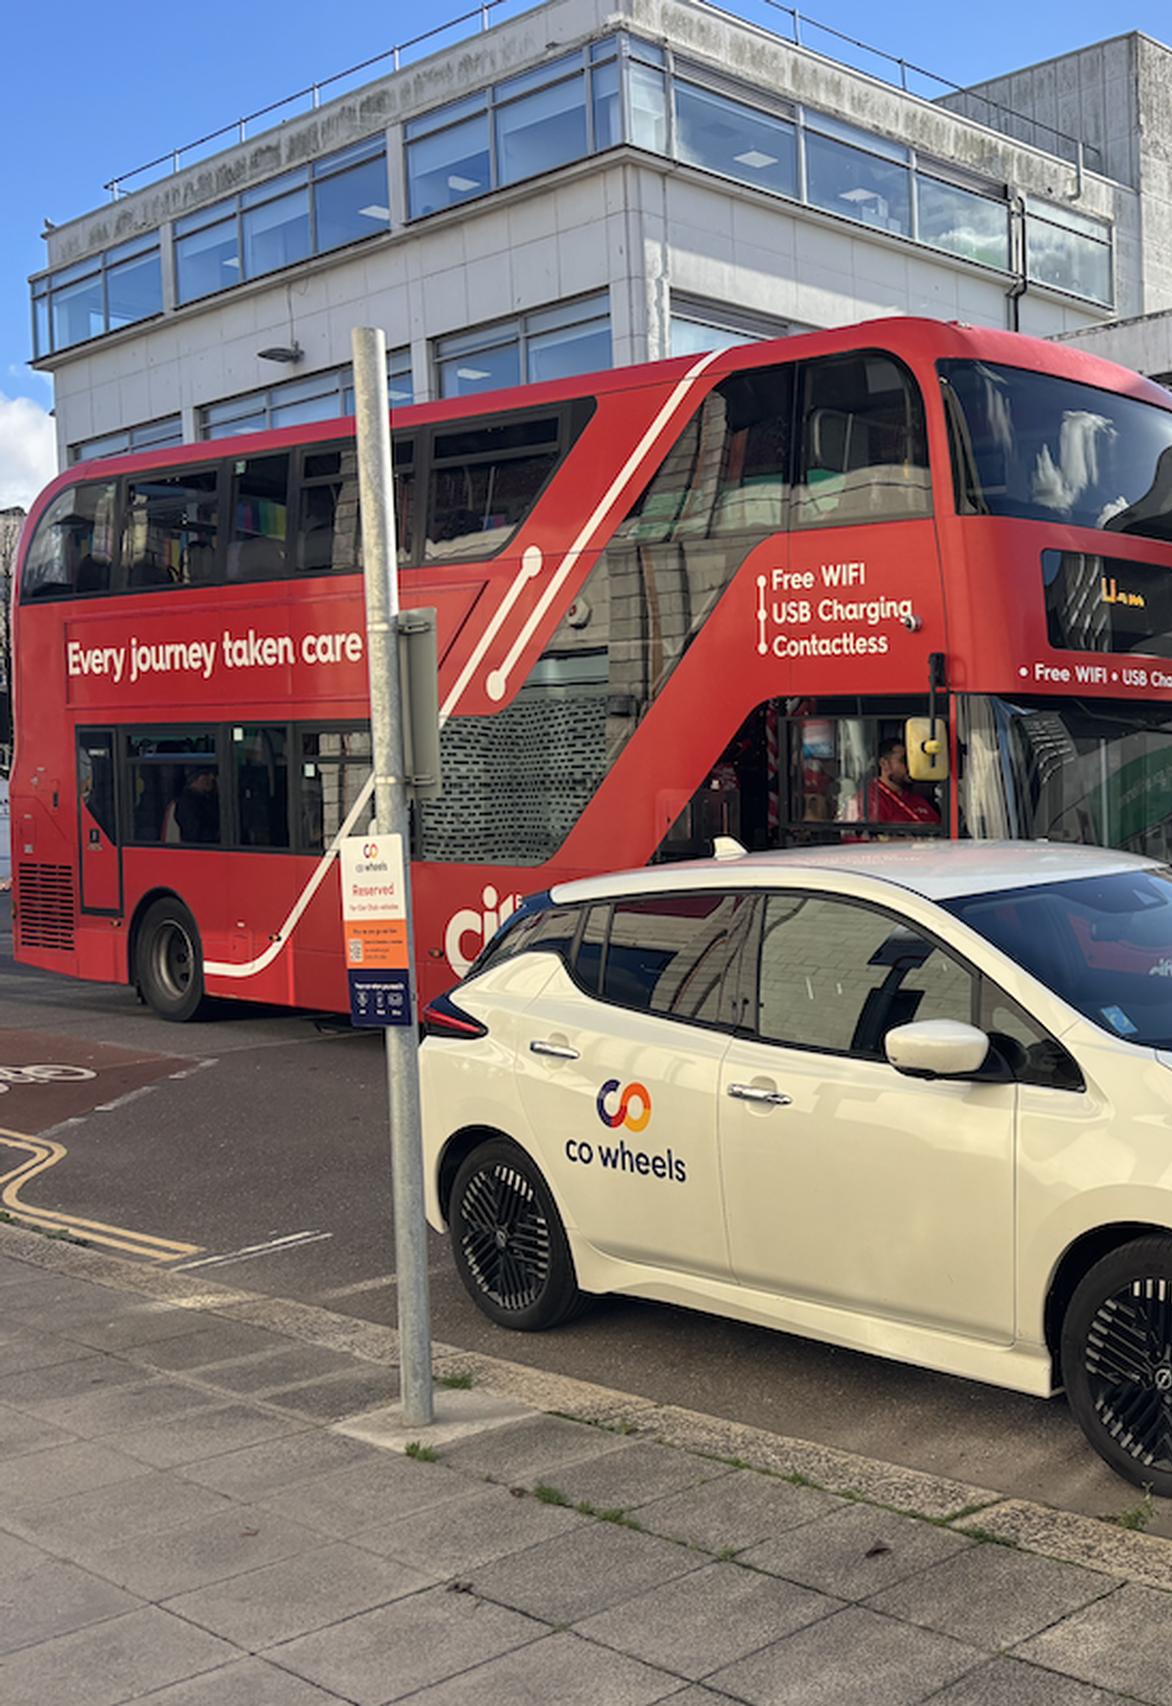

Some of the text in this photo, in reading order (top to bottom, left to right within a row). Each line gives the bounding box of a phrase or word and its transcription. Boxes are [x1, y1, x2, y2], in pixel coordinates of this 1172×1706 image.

[772, 562, 866, 591] Free WIFI
[772, 595, 912, 625] USB Charging
[67, 630, 363, 683] Every journey taken care
[773, 632, 888, 657] Contactless
[1034, 664, 1070, 682] Free
[1075, 665, 1107, 683] WIFI
[1122, 669, 1148, 687] USB
[352, 882, 394, 897] Reserved
[565, 1139, 687, 1183] co wheels
